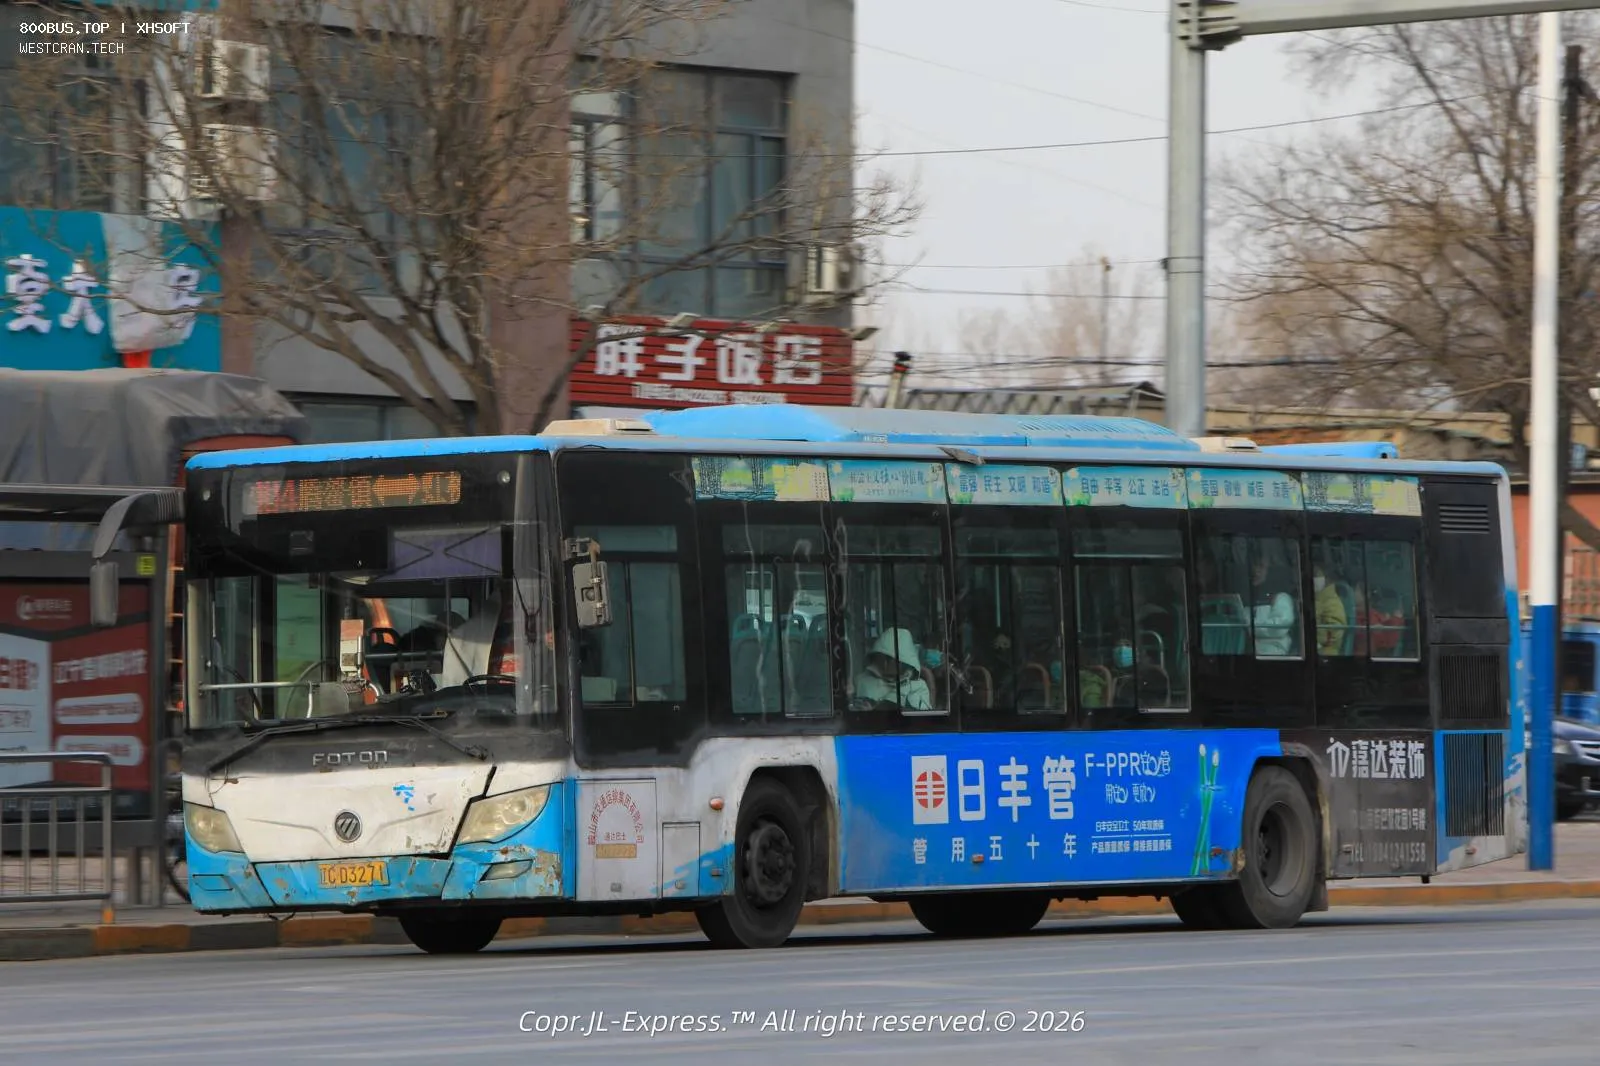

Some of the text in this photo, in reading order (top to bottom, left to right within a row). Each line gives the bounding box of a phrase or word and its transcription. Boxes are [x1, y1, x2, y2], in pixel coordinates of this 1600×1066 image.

[594, 323, 823, 386] 胖子饭店
[959, 474, 978, 492] 富强
[984, 475, 1002, 492] 民主
[1007, 476, 1026, 492] 文明
[1081, 477, 1170, 496] 自由 平等 公正 法治
[1200, 479, 1219, 497] 爱国
[312, 750, 388, 767] FOTON
[957, 754, 1077, 823] 日丰管
[912, 832, 1078, 865] 管用五十年
[320, 863, 386, 885] CD3271
